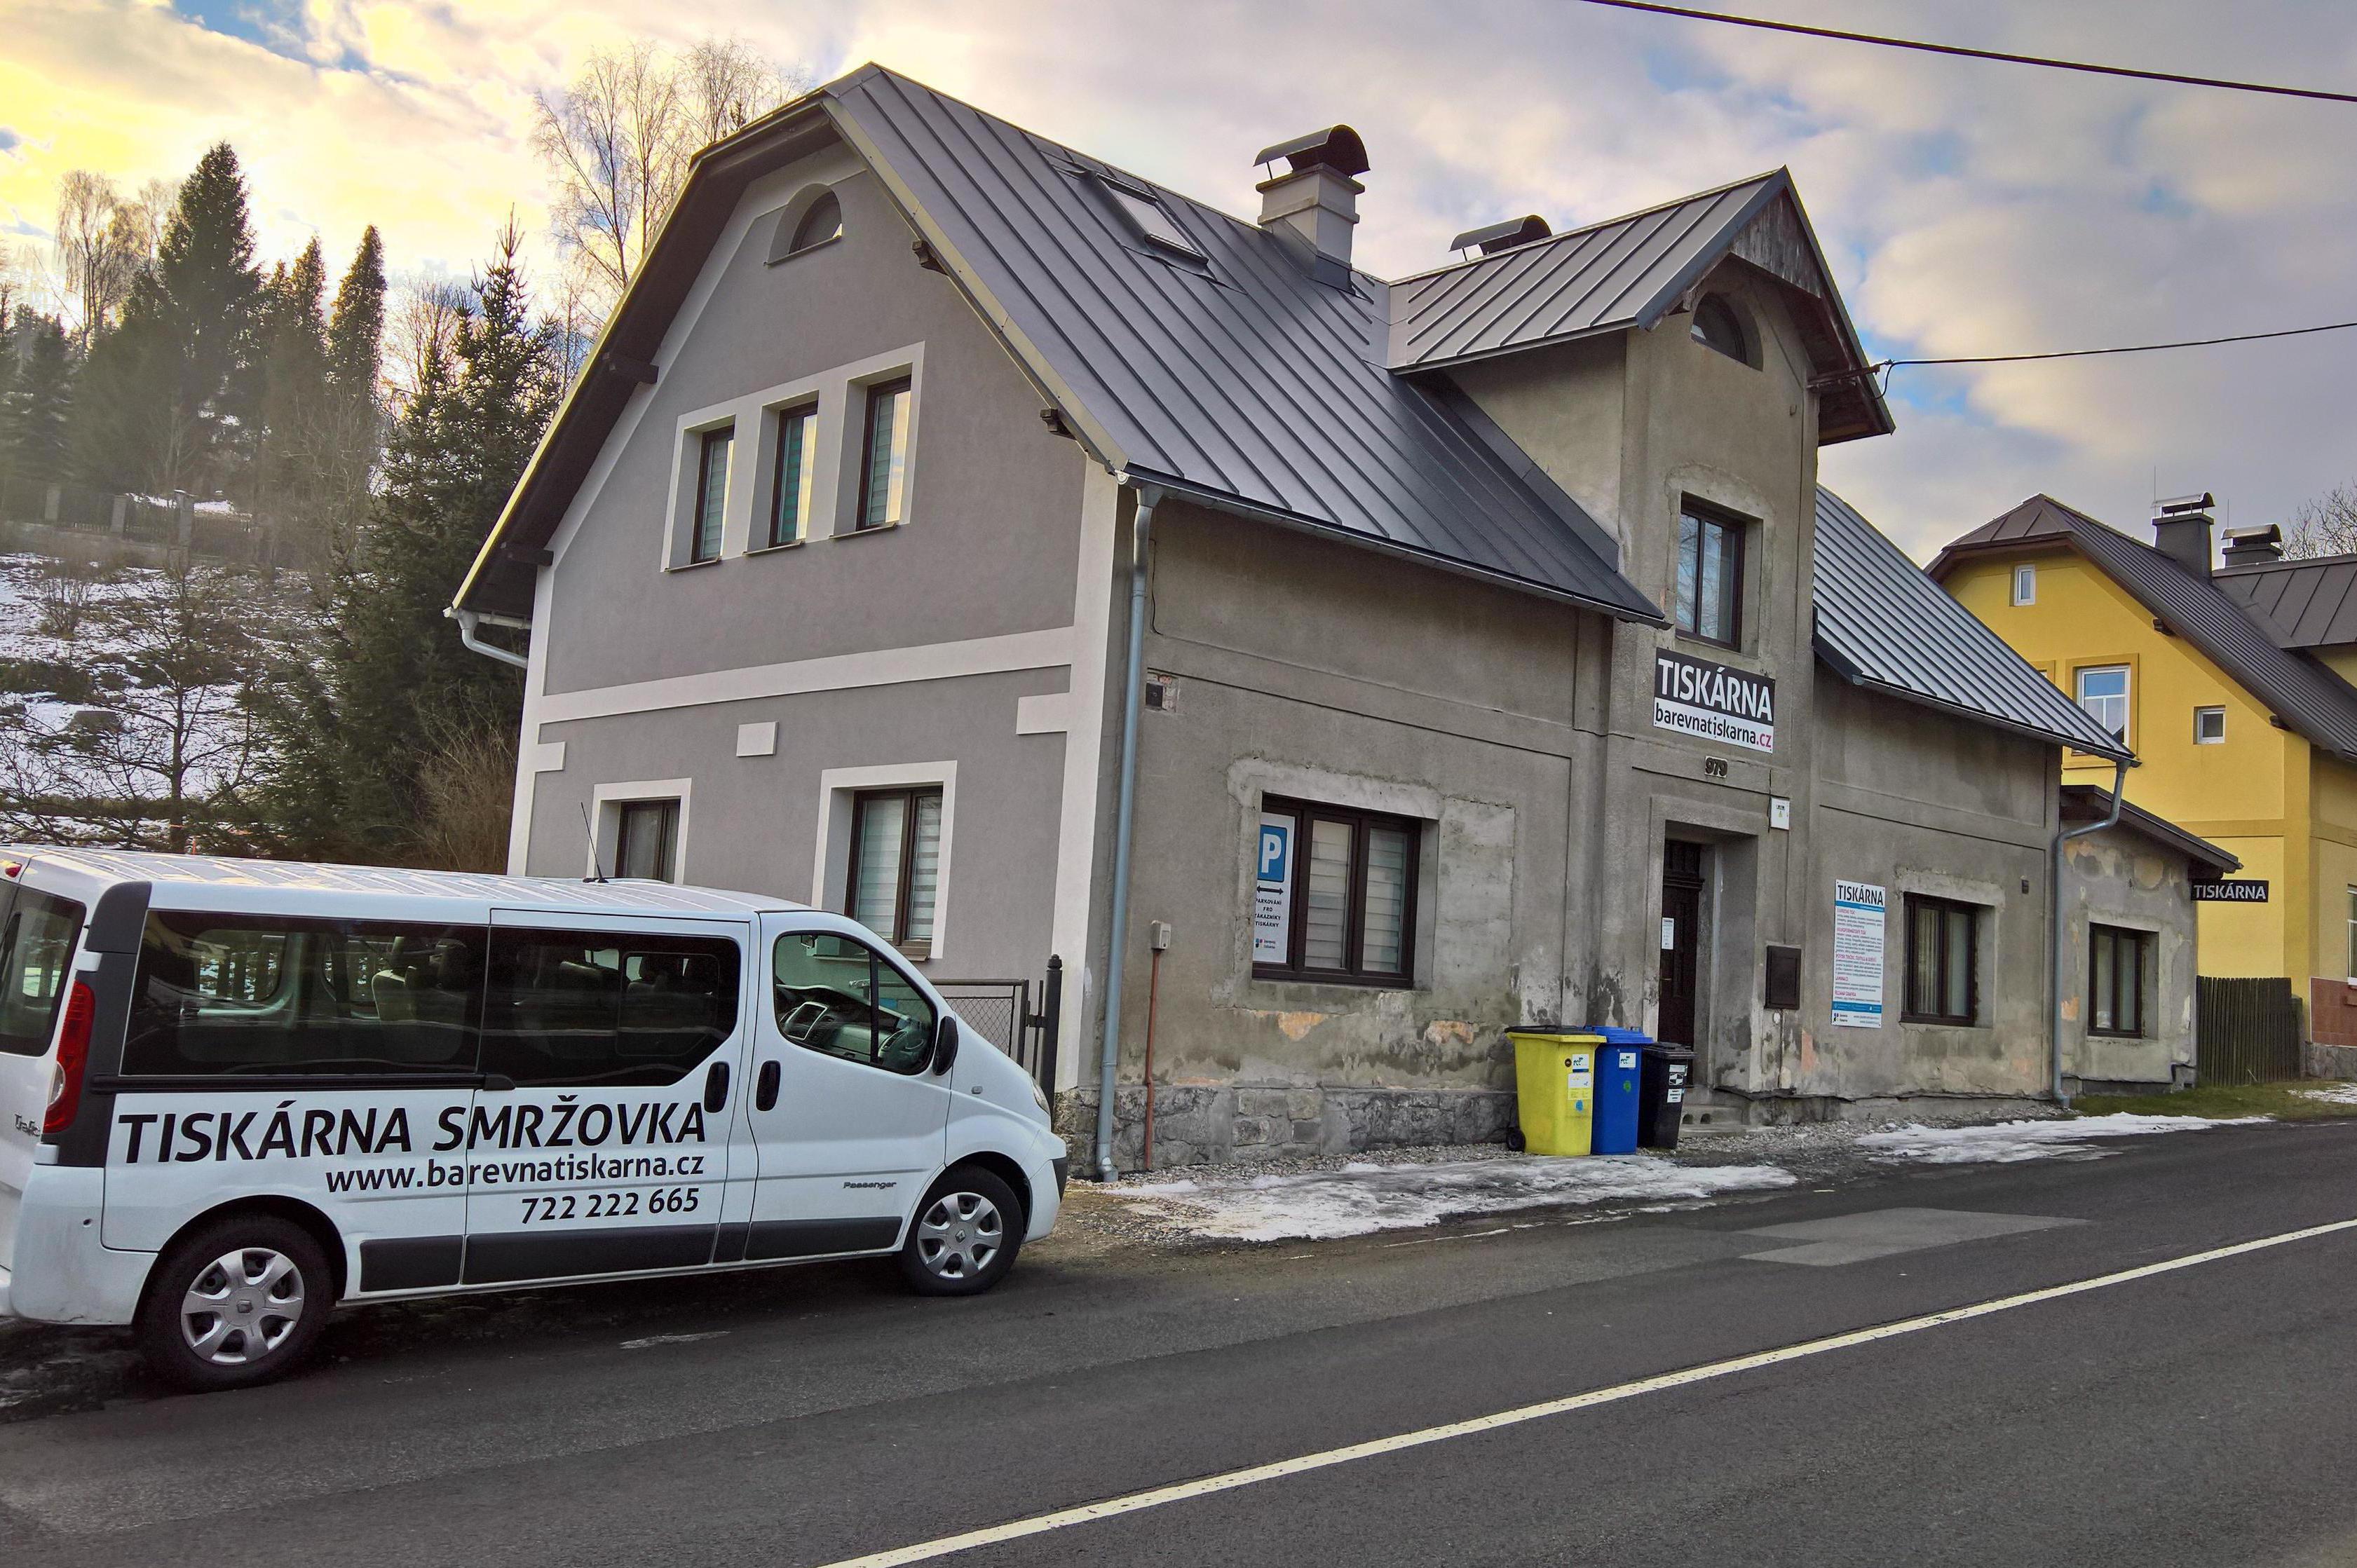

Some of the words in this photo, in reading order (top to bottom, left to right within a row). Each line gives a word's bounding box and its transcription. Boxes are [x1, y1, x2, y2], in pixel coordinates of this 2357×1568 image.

[1658, 658, 1773, 722] TISKÁRNA
[1655, 702, 1772, 748] barevnatiskarna.cz
[1705, 757, 1728, 777] 979
[1261, 833, 1282, 873] P
[1838, 885, 1884, 906] TISKÁRNA
[2193, 882, 2267, 899] TISKÁRNA
[118, 1100, 412, 1164] TISKÁRNA
[432, 1095, 706, 1151] SMRŽOVKA
[326, 1153, 705, 1193] www.barevnatiskarna.cz
[522, 1196, 576, 1224] 722
[585, 1192, 639, 1218] 222
[648, 1187, 700, 1214] 665
